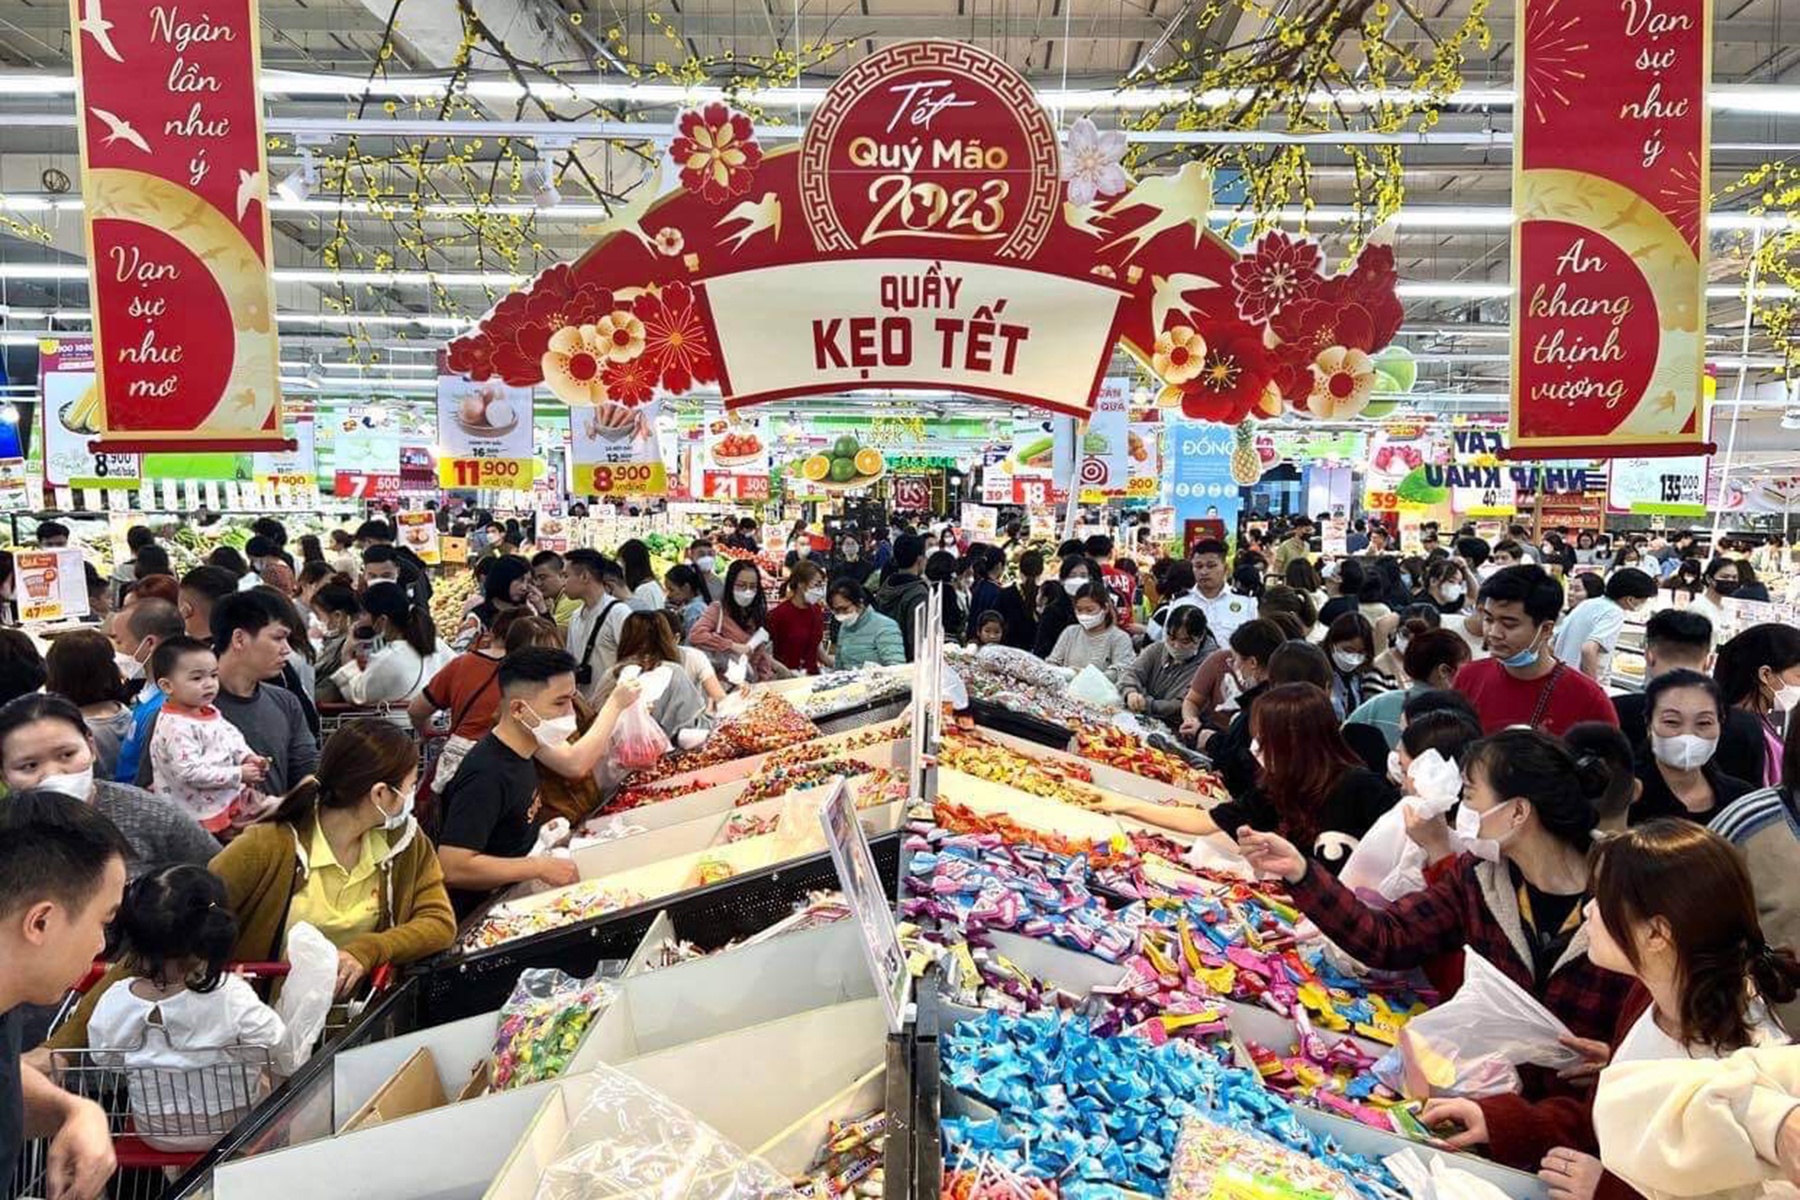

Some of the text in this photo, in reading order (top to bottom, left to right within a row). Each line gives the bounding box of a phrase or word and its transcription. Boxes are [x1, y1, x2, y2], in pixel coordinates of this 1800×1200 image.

[150, 6, 236, 52] Ngàn
[1620, 0, 1694, 41] Vạn
[168, 58, 222, 93] lần
[1635, 46, 1678, 77] sự
[164, 103, 231, 138] như
[886, 79, 977, 133] Tết
[1619, 83, 1690, 120] như
[189, 149, 210, 186] ý
[848, 136, 1009, 173] Quý Mão
[1641, 128, 1666, 169] ý
[861, 175, 1011, 245] 2023
[110, 245, 181, 288] Vạn
[1555, 237, 1610, 277] An
[880, 261, 963, 314] QUẦY
[1528, 283, 1635, 328] khang
[128, 295, 168, 325] sự
[118, 331, 184, 364] như
[812, 299, 1030, 380] KẸO TẾT
[1533, 328, 1628, 371] thịnh
[128, 374, 179, 398] mơ
[1530, 372, 1630, 410] vượng
